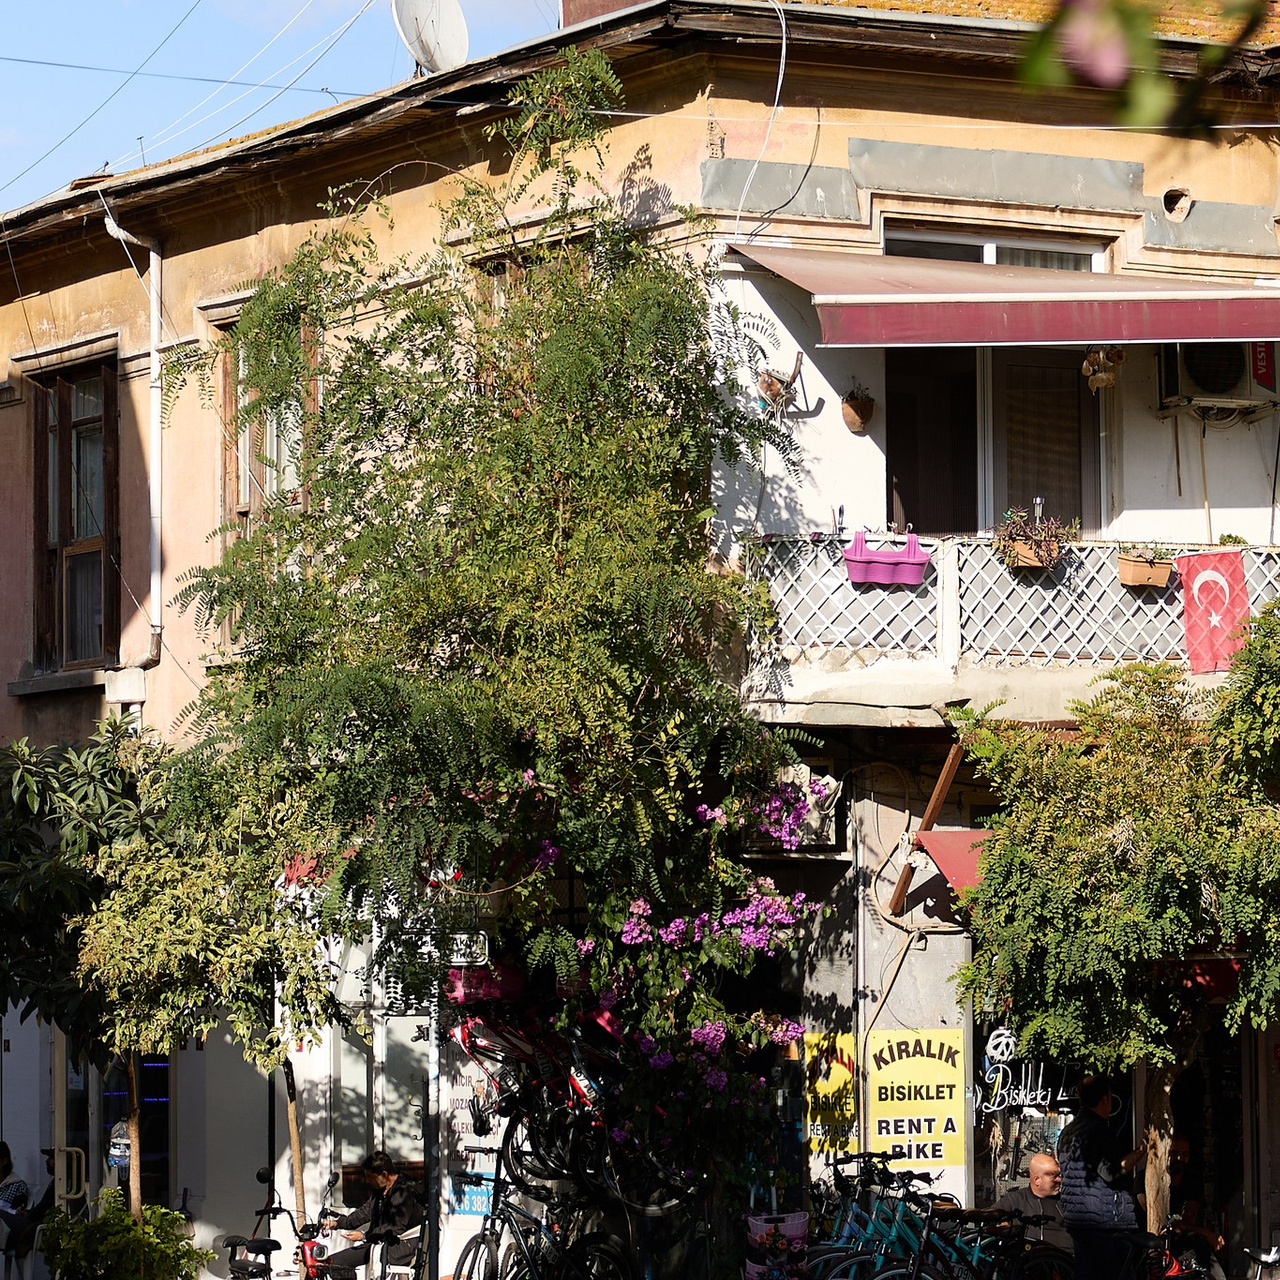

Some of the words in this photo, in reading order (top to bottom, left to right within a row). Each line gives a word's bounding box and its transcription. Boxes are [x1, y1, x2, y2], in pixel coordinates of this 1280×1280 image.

[872, 1038, 961, 1072] KİRALIK
[877, 1080, 957, 1102] BİSİKLET
[877, 1118, 937, 1136] RENT
[943, 1116, 957, 1134] A
[471, 1195, 488, 1213] 382
